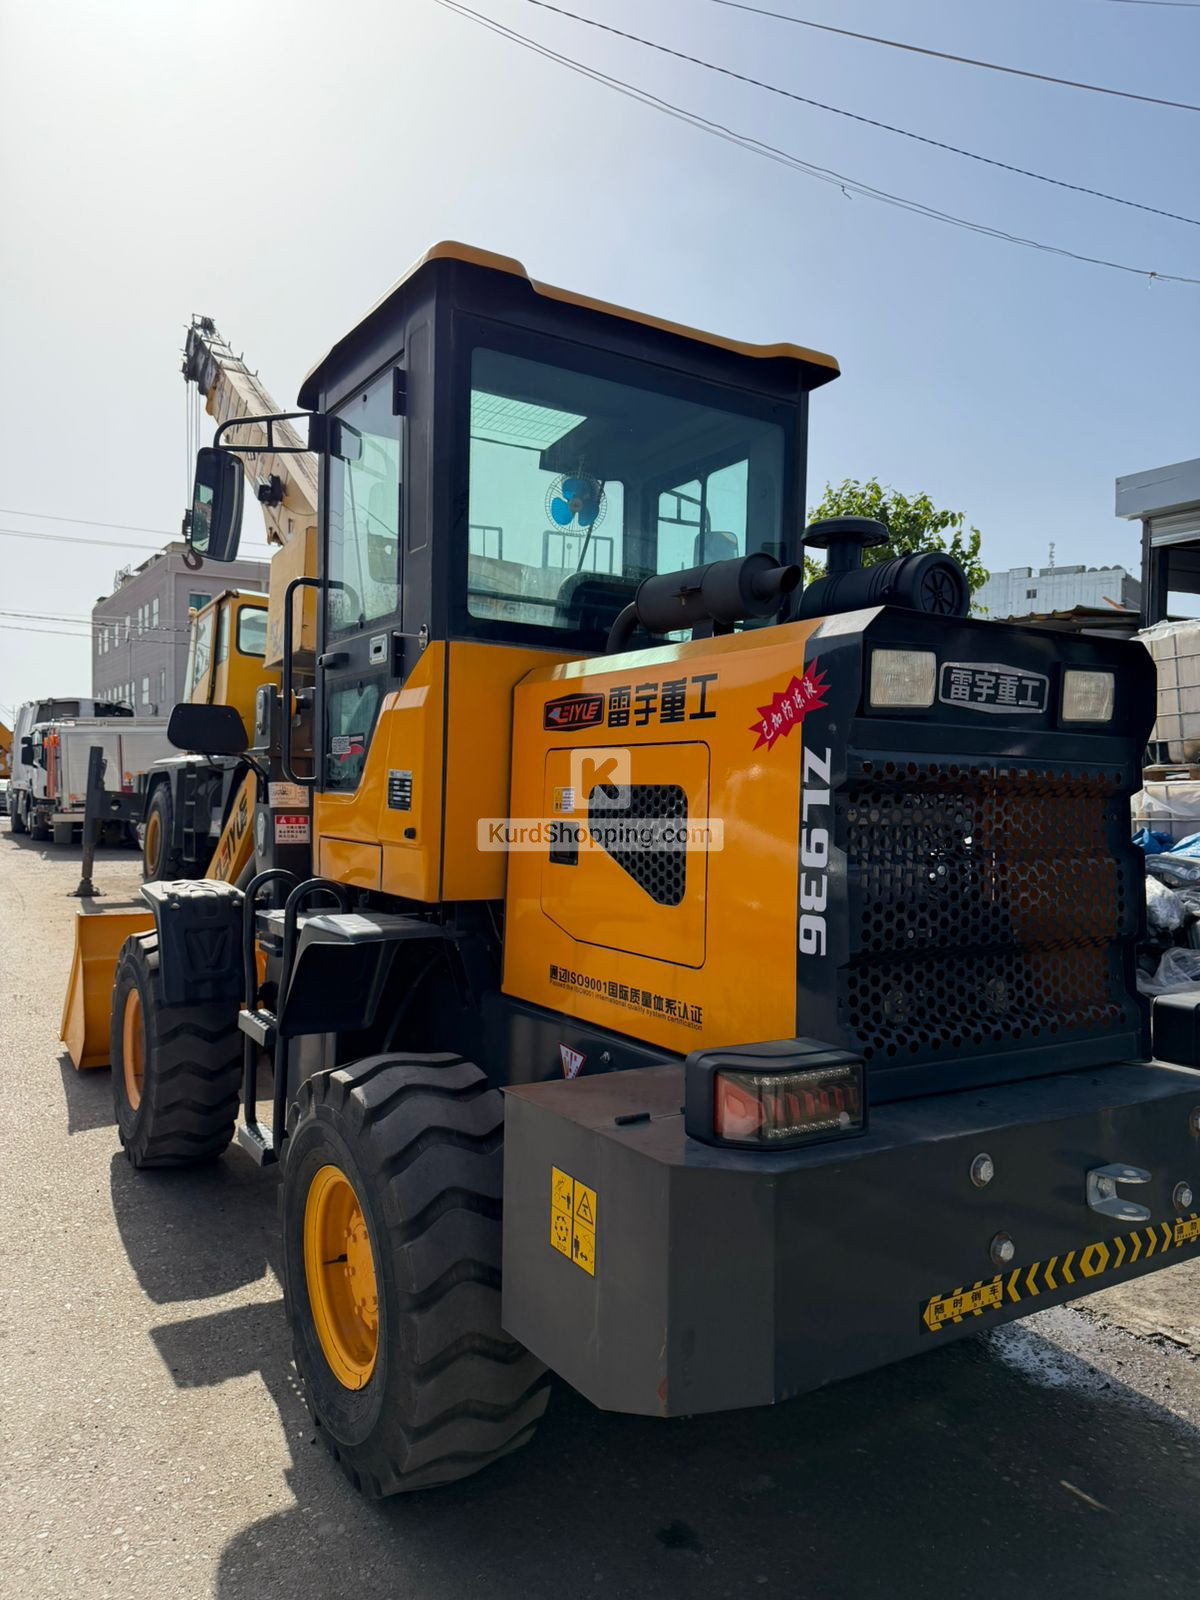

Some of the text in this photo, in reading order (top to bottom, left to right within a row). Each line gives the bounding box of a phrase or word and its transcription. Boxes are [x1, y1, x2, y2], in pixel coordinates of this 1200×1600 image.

[607, 673, 718, 728] 雷宇重工
[949, 667, 1041, 707] 雷宇重工
[799, 746, 832, 956] ZL936
